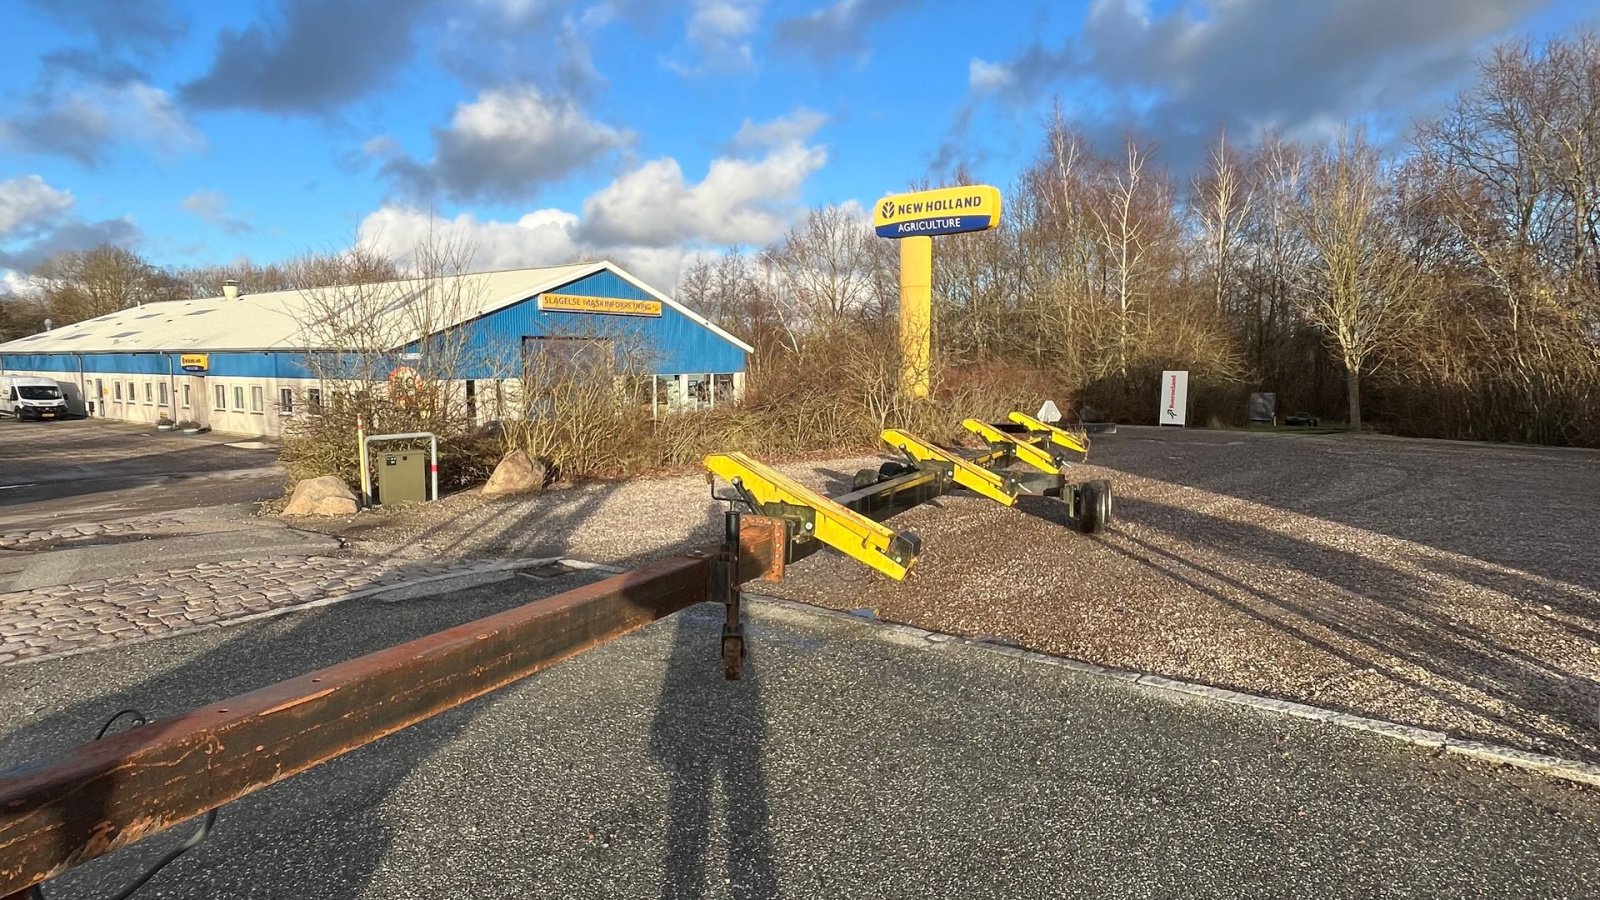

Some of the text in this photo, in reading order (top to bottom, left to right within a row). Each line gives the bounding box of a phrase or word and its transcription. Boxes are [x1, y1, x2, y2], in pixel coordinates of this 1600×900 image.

[898, 196, 981, 215] NEW HOLLAND
[898, 217, 961, 233] AGRICULTURE
[544, 296, 581, 306] SLAGELSE
